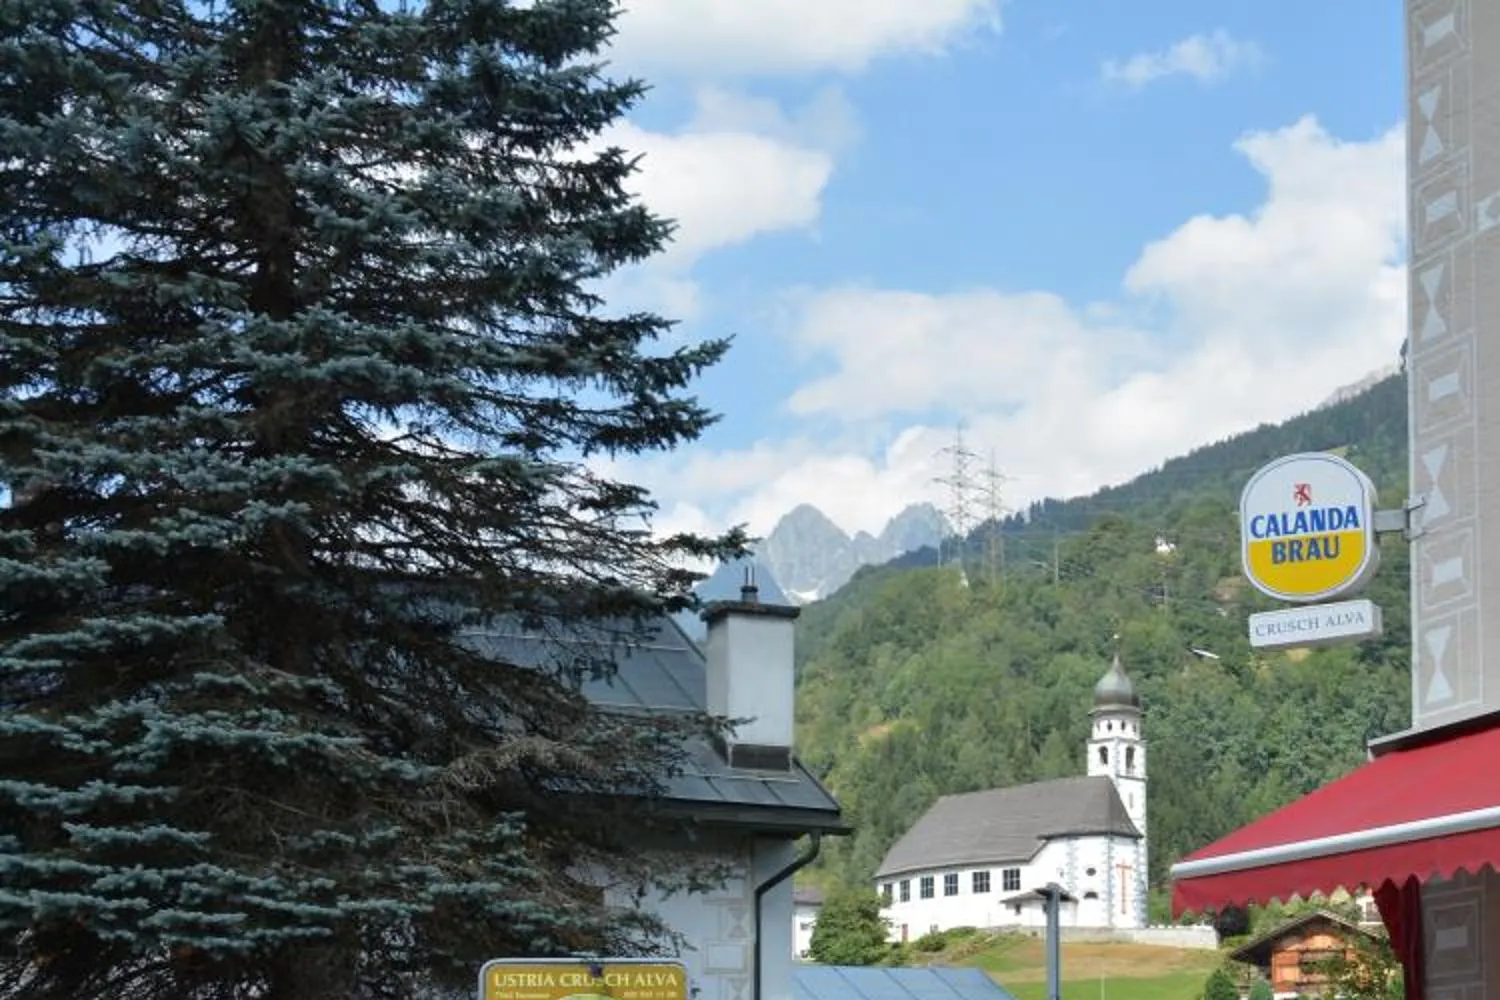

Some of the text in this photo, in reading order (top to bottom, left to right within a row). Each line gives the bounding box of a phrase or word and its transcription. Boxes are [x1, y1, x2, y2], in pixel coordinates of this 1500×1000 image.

[1251, 506, 1360, 539] CALANDA
[1255, 611, 1365, 638] CRUSCH ALVA
[494, 972, 555, 987] USTRIA
[634, 973, 678, 987] ALVA
